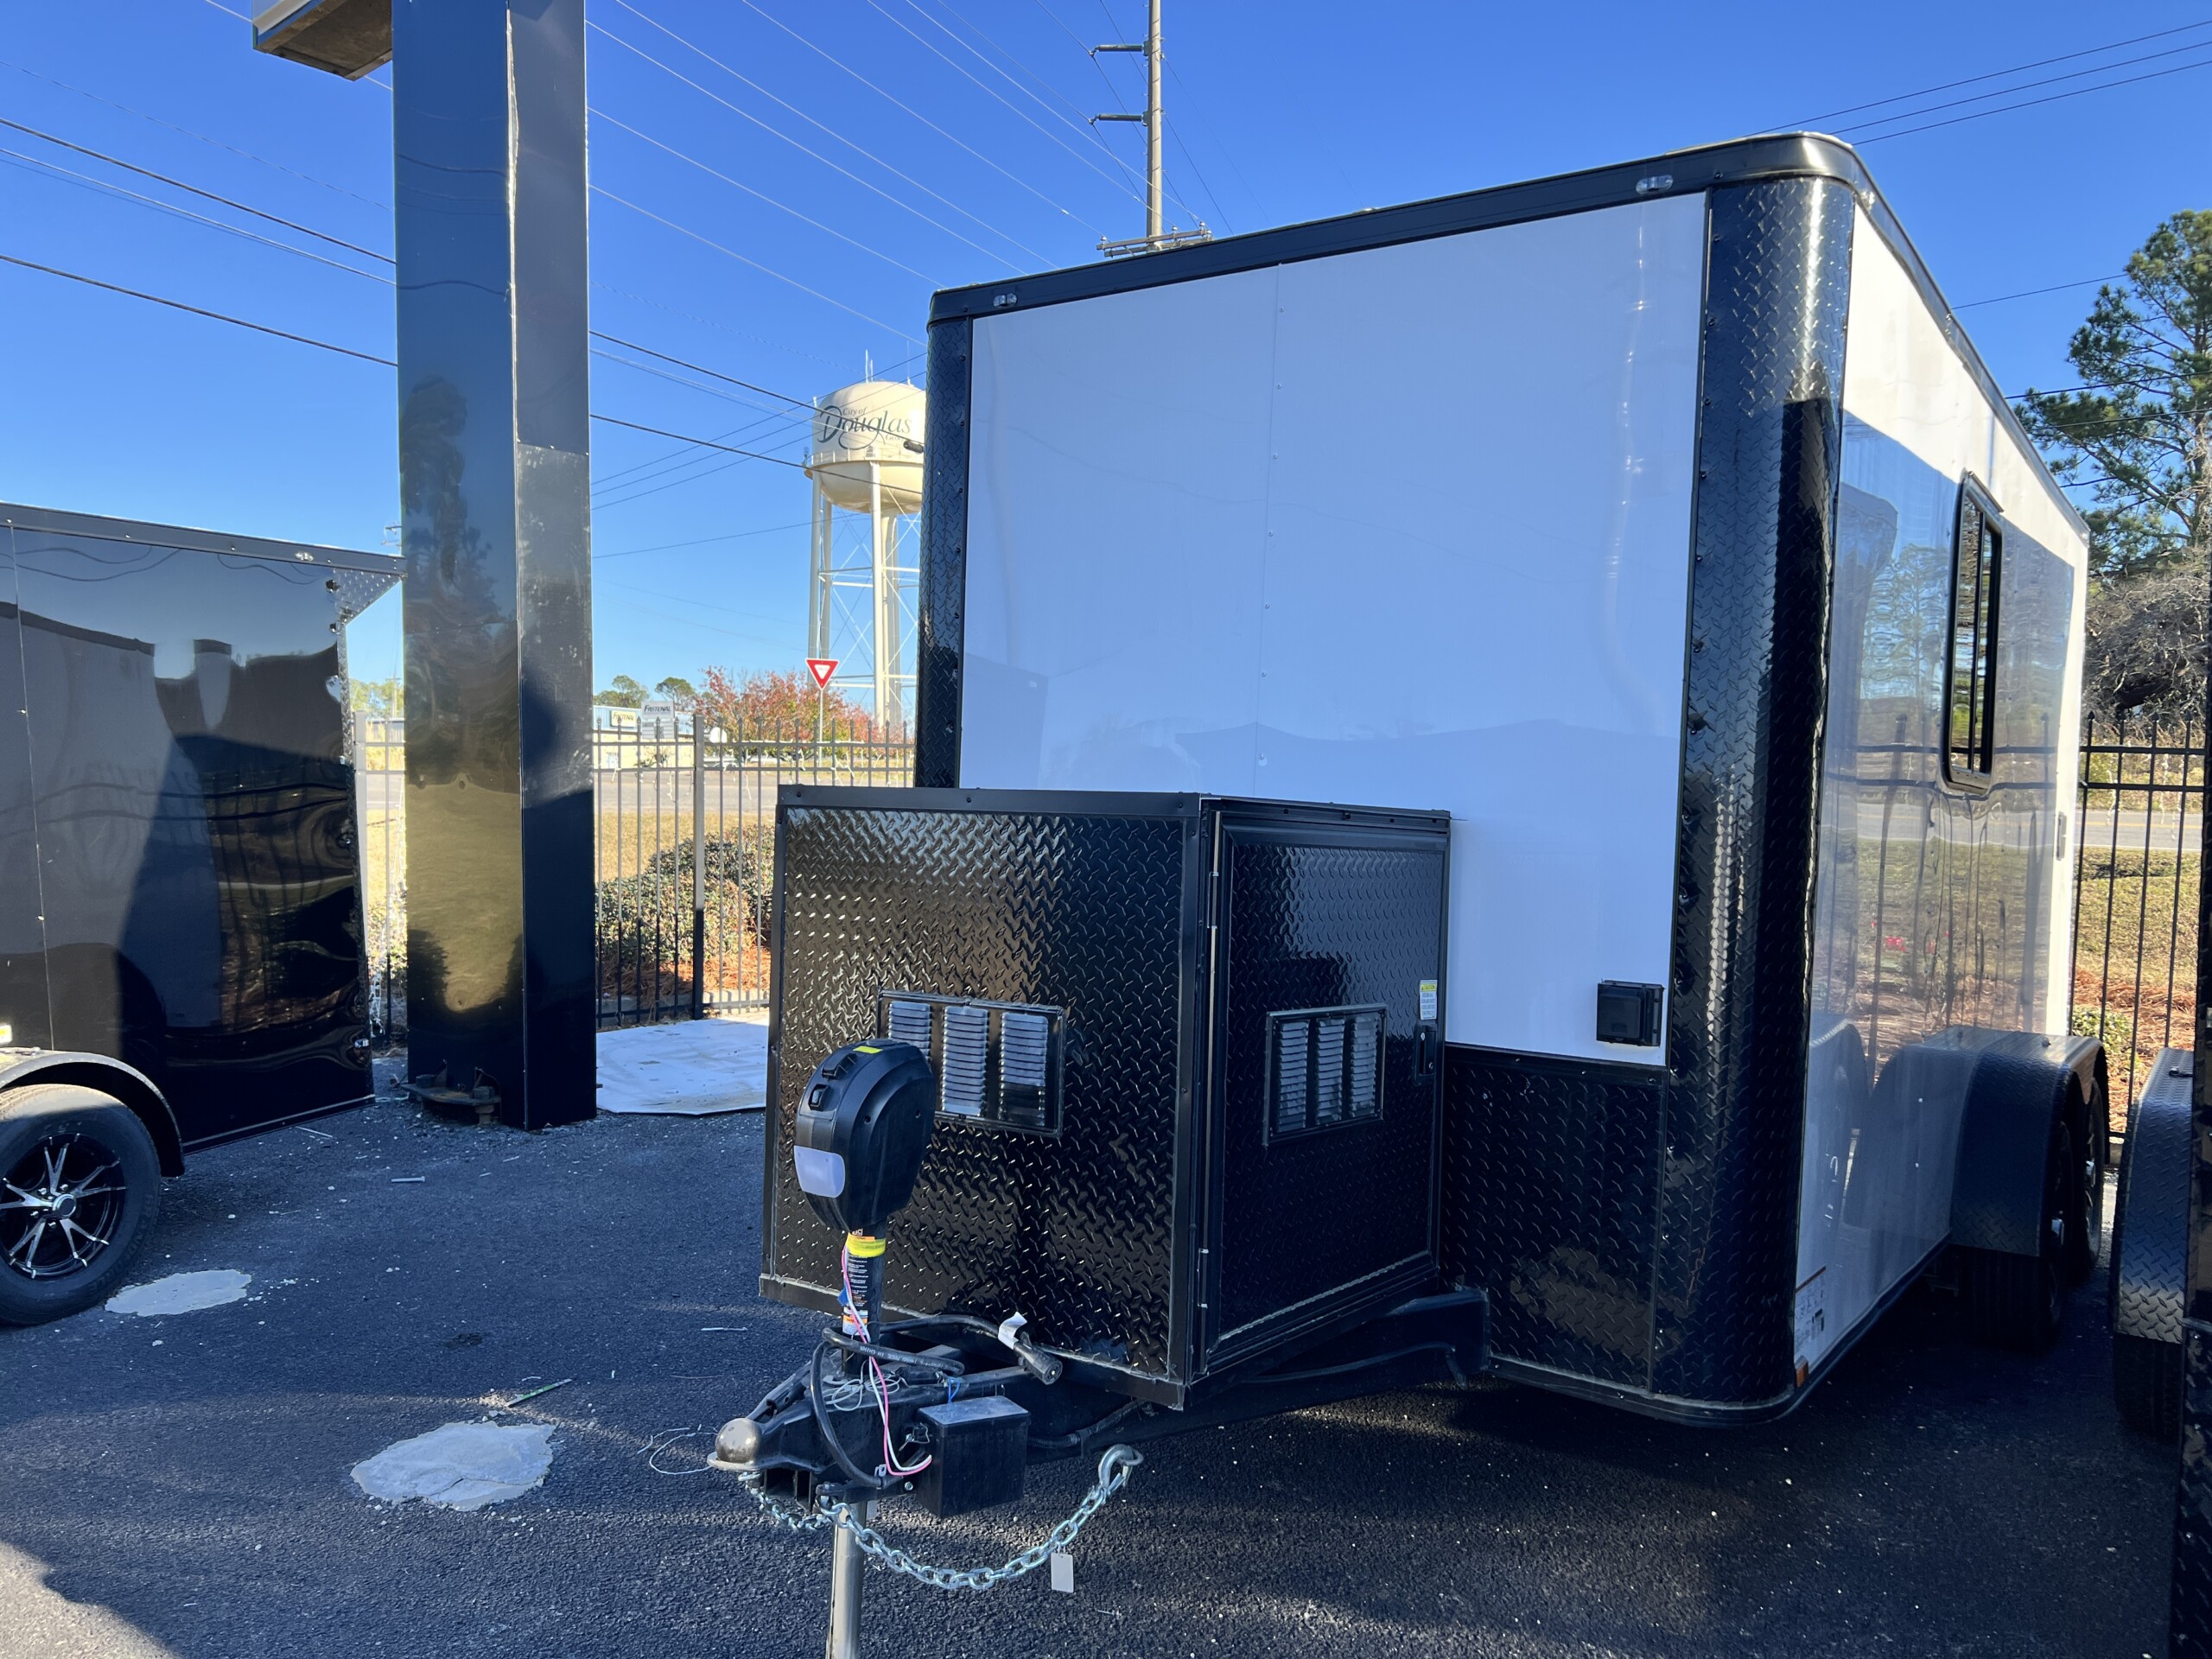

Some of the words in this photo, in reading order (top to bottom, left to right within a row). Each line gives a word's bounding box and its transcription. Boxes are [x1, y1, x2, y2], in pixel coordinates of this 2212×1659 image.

[842, 407, 857, 417] City
[858, 406, 868, 416] of
[817, 405, 912, 450] Douglas
[644, 704, 671, 713] FASTENAL
